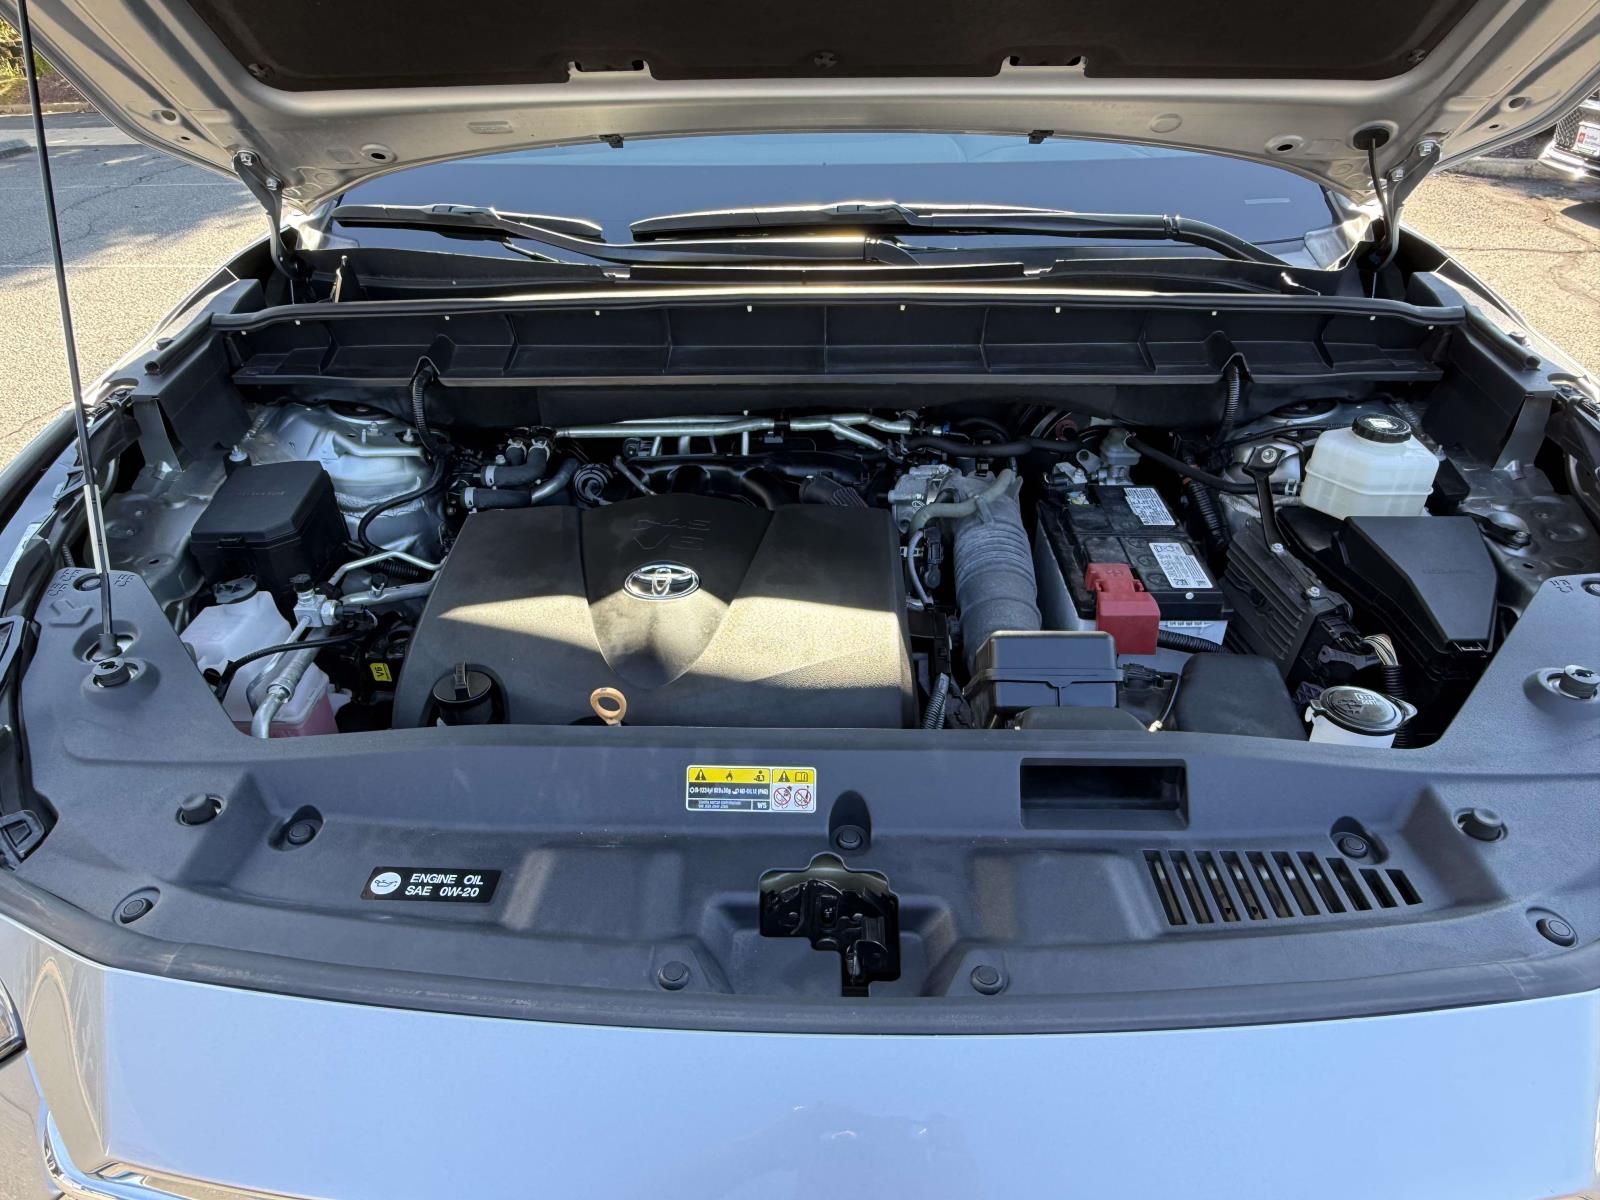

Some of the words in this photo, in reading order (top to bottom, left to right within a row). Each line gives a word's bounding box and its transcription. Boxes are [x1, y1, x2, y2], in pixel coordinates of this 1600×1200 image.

[410, 873, 458, 884] ENGINE
[463, 875, 484, 885] OIL
[404, 885, 433, 896] SAE
[439, 886, 480, 897] 0W-20
